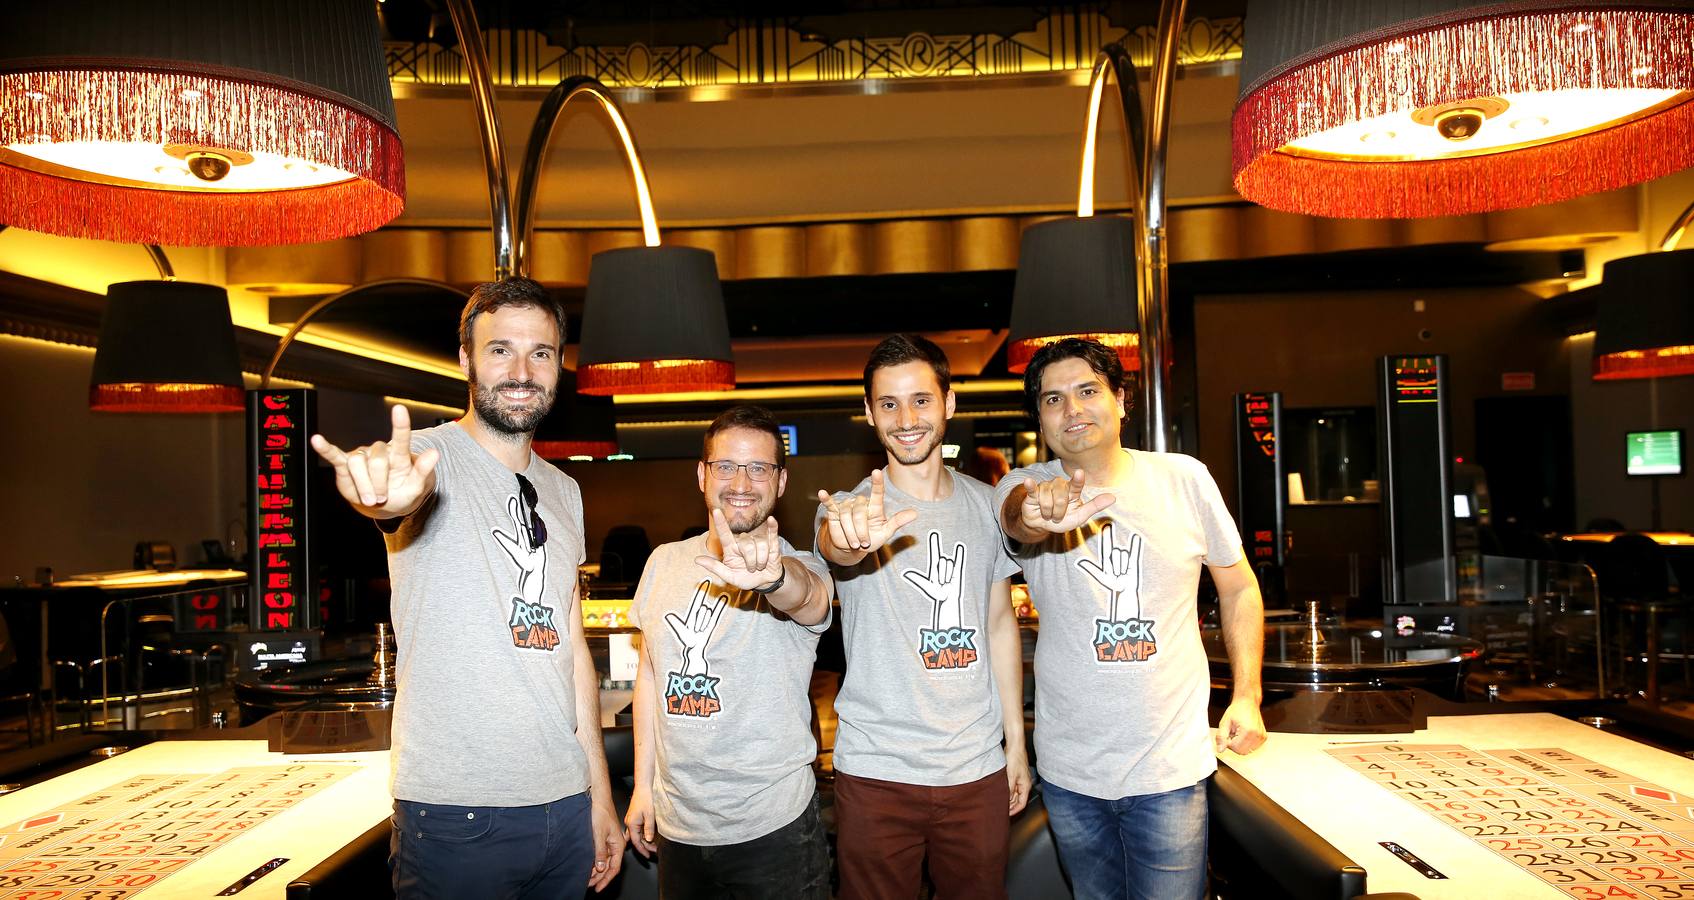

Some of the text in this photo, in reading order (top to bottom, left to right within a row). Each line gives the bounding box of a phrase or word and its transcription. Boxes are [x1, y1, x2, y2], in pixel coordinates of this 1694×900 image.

[510, 600, 557, 631] ROCK
[511, 624, 559, 650] CAMP
[1095, 620, 1154, 647] ROCK
[921, 628, 974, 655] ROCK
[1096, 640, 1157, 661] CAMP
[922, 648, 977, 668] CAMP
[667, 674, 719, 700] ROCK
[667, 694, 720, 716] CAMP
[1416, 761, 1435, 769] 5
[1378, 771, 1397, 780] 7
[1482, 768, 1505, 776] 9
[1386, 777, 1539, 789] 10 11 12
[1406, 788, 1560, 800] 13 14 15
[150, 800, 293, 809] 10 11 12
[1422, 798, 1587, 811] 16 17 18
[1597, 792, 1653, 813] Docena
[127, 810, 274, 820] 13 14 15
[1443, 809, 1614, 822] 19 20 21
[102, 821, 254, 831] 16 17 18
[1463, 821, 1643, 836] 22 23 24
[16, 826, 80, 848] Docena
[71, 832, 231, 843] 19 20 21
[1488, 835, 1671, 850] 25 26 27
[38, 845, 210, 856] 22 23 24
[1514, 852, 1575, 866] 28
[1580, 851, 1638, 864] 29
[4, 860, 189, 872] 25 26 27
[32, 875, 96, 887] 29
[96, 874, 157, 887] 30
[1543, 866, 1680, 882] 31 32
[1571, 886, 1638, 900] 34
